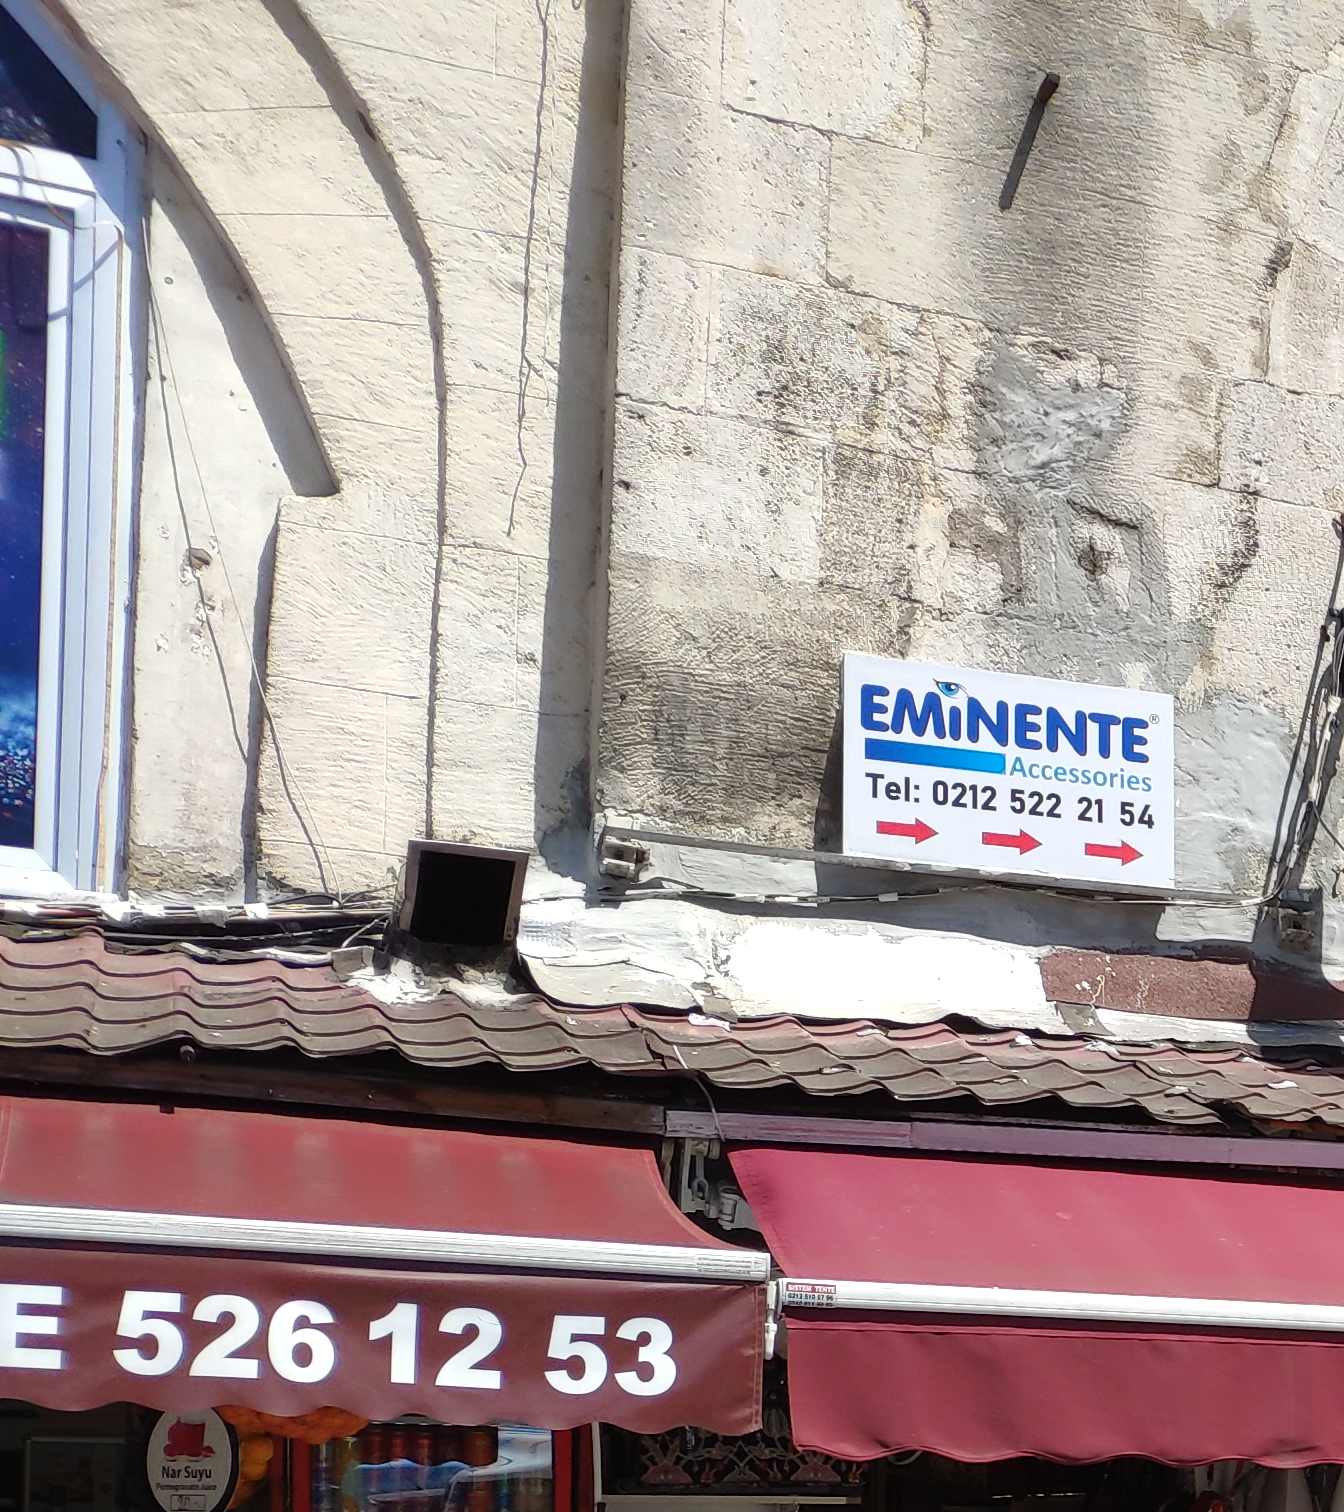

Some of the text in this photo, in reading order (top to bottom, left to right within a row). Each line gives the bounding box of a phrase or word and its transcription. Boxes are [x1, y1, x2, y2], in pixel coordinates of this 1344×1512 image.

[1009, 756, 1152, 793] Accessories
[865, 773, 1155, 829] Tel: 0212 522 21 54
[112, 1290, 337, 1383] 526
[368, 1302, 501, 1390] 12
[544, 1314, 677, 1396] 53
[161, 1465, 212, 1481] Nar Suyu
